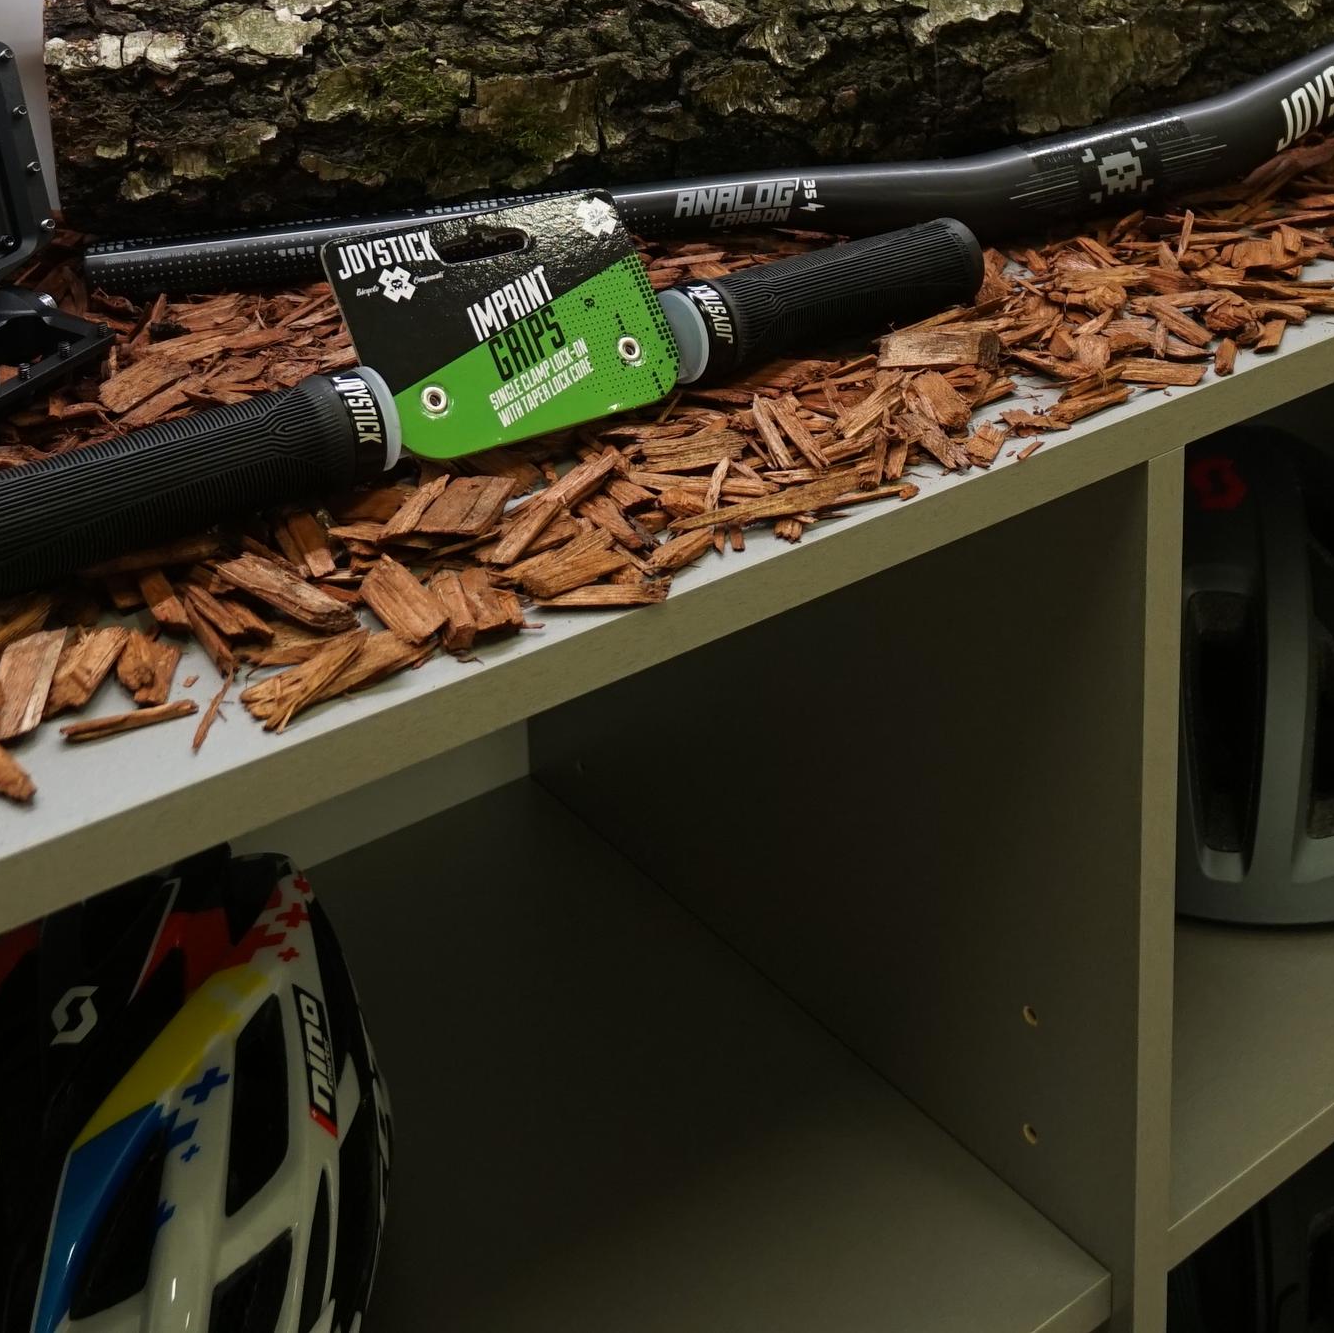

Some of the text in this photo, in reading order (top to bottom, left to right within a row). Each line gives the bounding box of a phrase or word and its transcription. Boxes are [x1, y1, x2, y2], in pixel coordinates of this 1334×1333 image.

[674, 179, 817, 218] ANALOG 35
[710, 207, 791, 228] CARBON
[337, 230, 441, 280] JOYSTICK
[356, 283, 380, 297] Bicycle
[467, 265, 553, 342] IMPRINT
[687, 284, 734, 344] JOYSTICK
[488, 305, 566, 382] GRIPS
[489, 337, 588, 411] SINGLE CLAMP LOCK-ON
[332, 376, 382, 444] JOYSTICK
[498, 356, 594, 428] WITH TAPER LOCK CORE
[299, 992, 334, 1116] nino
